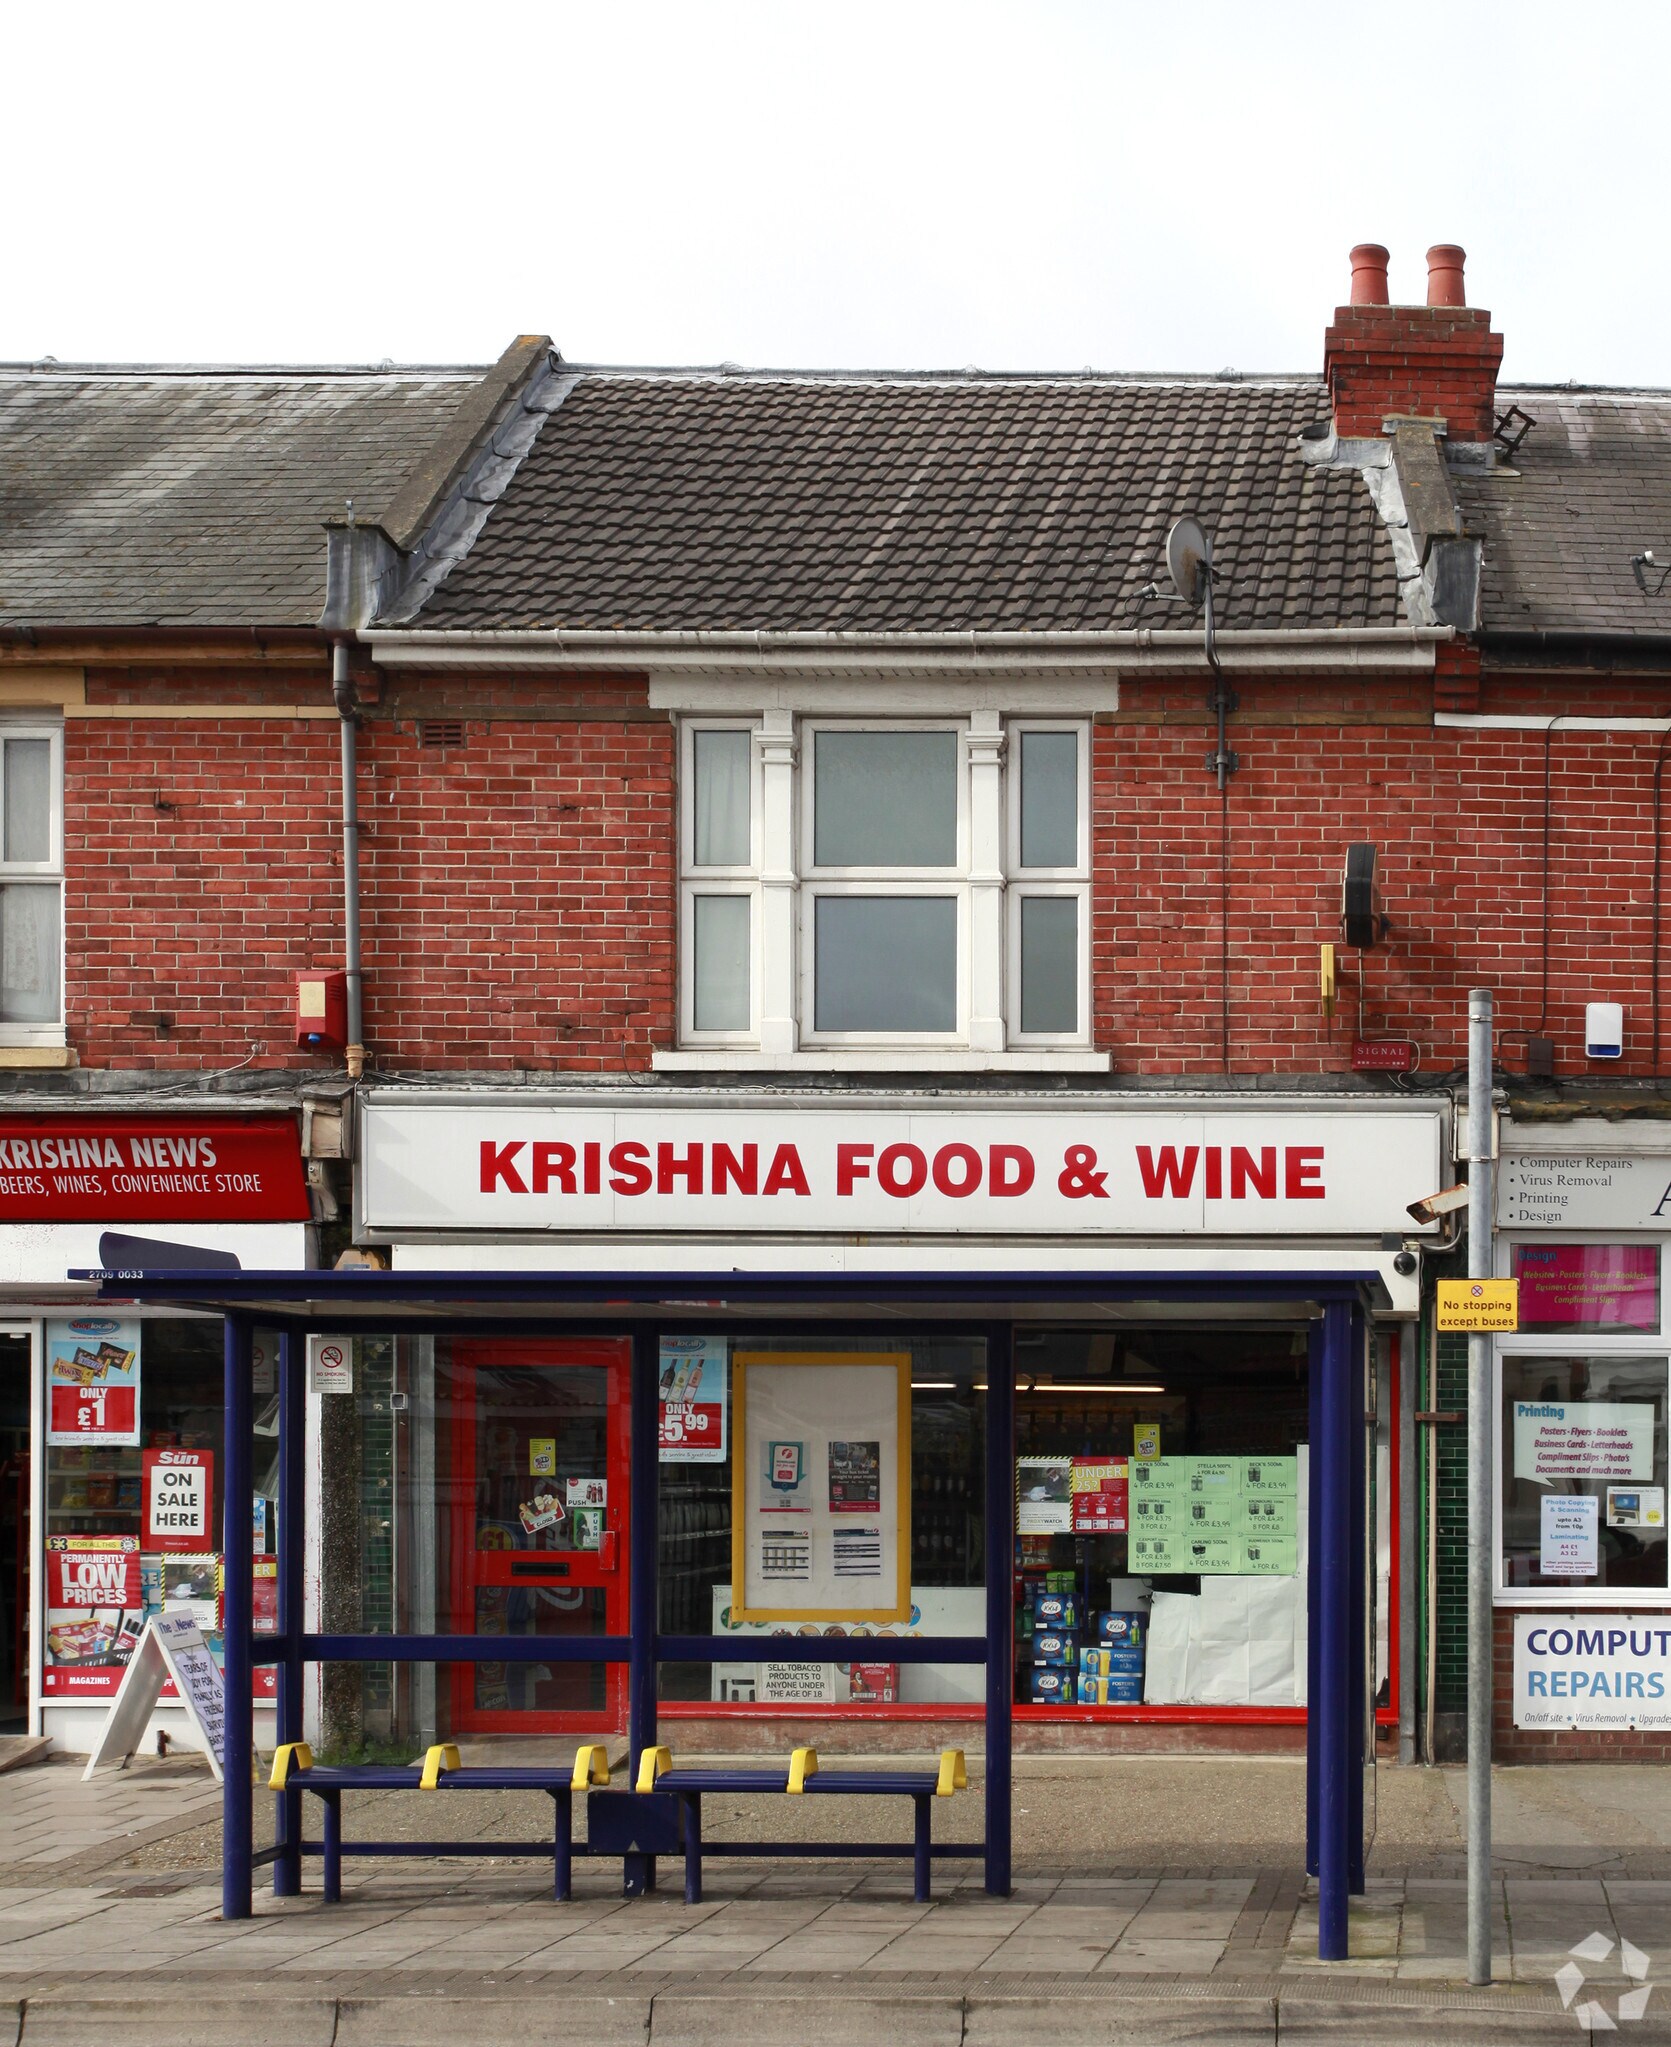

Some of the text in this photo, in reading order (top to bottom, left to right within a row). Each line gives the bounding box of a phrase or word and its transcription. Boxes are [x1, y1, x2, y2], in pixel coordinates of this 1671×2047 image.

[1357, 1047, 1405, 1056] SIGNAL
[0, 1137, 217, 1169] KRISHNA NEWS
[480, 1140, 1326, 1199] KRISHNA FOOD & WINE
[1519, 1157, 1632, 1171] Computer Repairs
[0, 1174, 262, 1197] BEERS, WINES, CONVENIENCE STORE
[1519, 1174, 1612, 1187] Virus Removal
[1519, 1191, 1568, 1206] Printing
[1518, 1209, 1562, 1223] Design
[1518, 1249, 1557, 1263] Design
[89, 1270, 143, 1279] 2709 0033
[1523, 1270, 1647, 1280] Websites Posters Flyers Booklets
[1535, 1283, 1634, 1292] Business Cards Letterheads
[1554, 1295, 1616, 1304] Compliment Slips
[1443, 1301, 1512, 1312] No stopping
[1440, 1317, 1514, 1327] except buses
[80, 1387, 109, 1399] ONLY
[77, 1398, 105, 1427] £1
[666, 1403, 694, 1415] ONLY
[1518, 1405, 1565, 1420] Printing
[1540, 1427, 1627, 1437] Posters Flyers Booklets
[1534, 1439, 1633, 1449] Business Cards Letterheads
[158, 1451, 199, 1465] Sun
[1537, 1452, 1630, 1463] Compliment Slips Photo's
[1075, 1465, 1122, 1479] UNDER
[1535, 1464, 1575, 1474] Documents
[1576, 1465, 1590, 1474] and
[1591, 1466, 1611, 1475] much
[163, 1472, 192, 1487] ON
[1267, 1481, 1287, 1489] £3.99
[1076, 1480, 1099, 1492] 25?
[157, 1492, 198, 1506] SALE
[155, 1512, 199, 1527] HERE
[536, 1516, 554, 1528] CLOSED
[1211, 1520, 1231, 1528] £3.99
[49, 1537, 68, 1552] £3
[61, 1553, 126, 1564] PERMANENTLY
[60, 1563, 128, 1589] LOW
[62, 1588, 127, 1605] PRICES
[158, 1618, 196, 1634] The News
[1526, 1628, 1671, 1657] COMPUT
[767, 1663, 822, 1672] SELL TOBACCO
[69, 1676, 111, 1685] MAGAZINES
[769, 1672, 821, 1680] PRODUCTS TO
[766, 1681, 825, 1690] ANYONE UNDER
[1527, 1671, 1666, 1699] REPAIRS
[769, 1690, 823, 1698] THE AGE OF 18
[1524, 1712, 1628, 1723] On/off site Virus Removal
